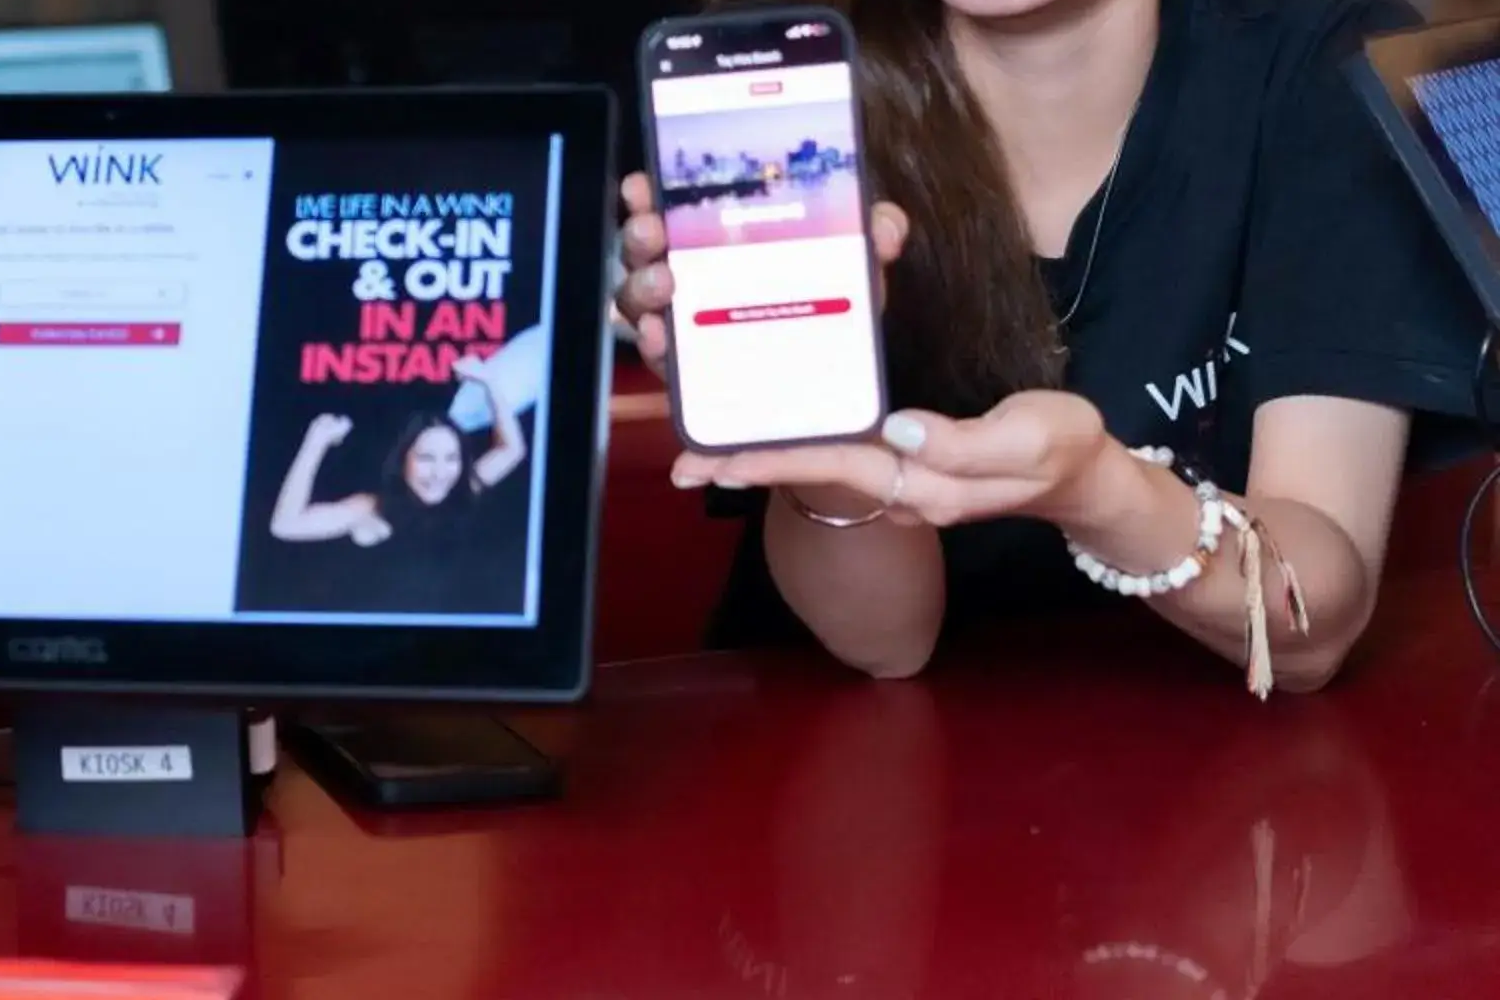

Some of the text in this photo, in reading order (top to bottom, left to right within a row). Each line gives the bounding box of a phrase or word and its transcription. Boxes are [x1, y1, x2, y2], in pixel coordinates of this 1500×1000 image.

[48, 145, 163, 185] WINK
[295, 195, 336, 219] LIVE
[339, 194, 378, 219] LIFE
[380, 194, 411, 218] IN
[412, 195, 433, 217] A
[286, 218, 512, 260] CHECK-IN
[353, 260, 512, 301] & OUT
[359, 301, 506, 341] IN AN
[80, 752, 174, 776] KIOSK 4
